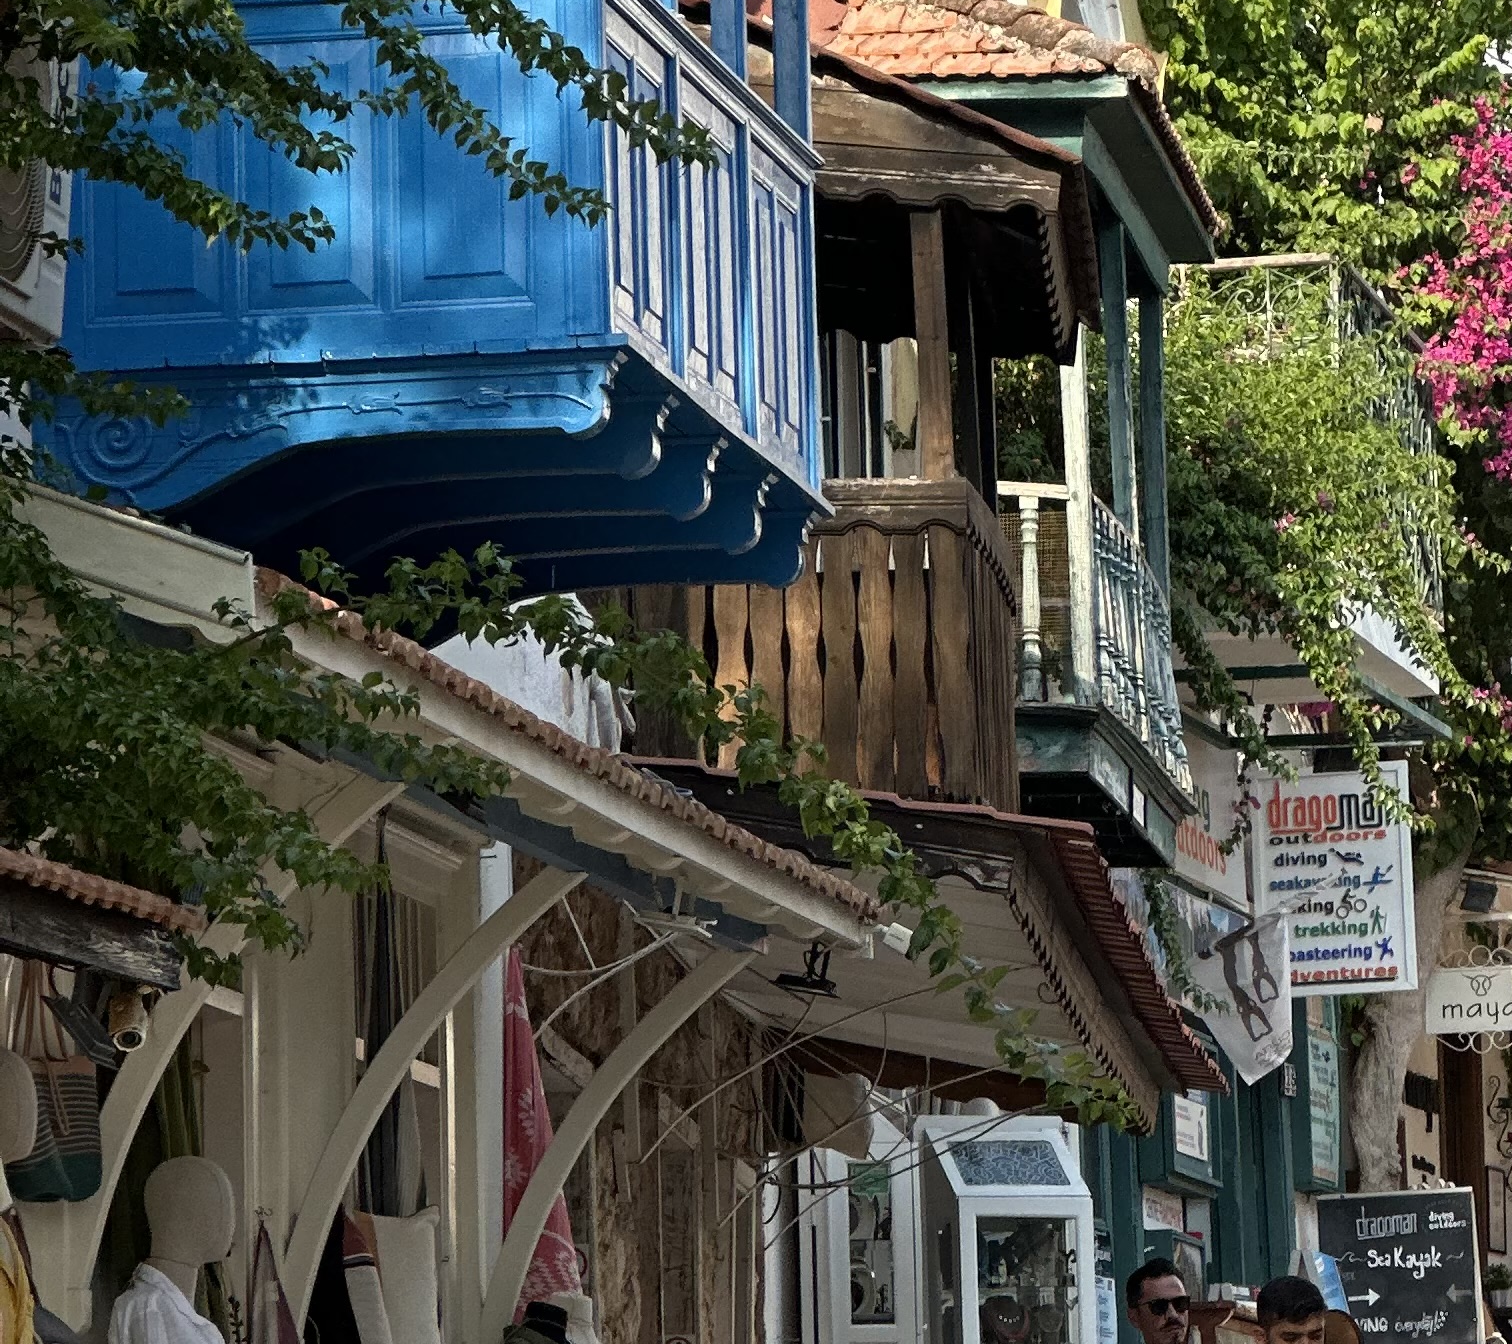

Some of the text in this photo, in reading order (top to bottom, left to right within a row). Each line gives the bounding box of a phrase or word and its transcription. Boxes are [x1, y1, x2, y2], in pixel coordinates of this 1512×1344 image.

[1177, 817, 1227, 876] utdoors
[1269, 828, 1387, 846] outdoors
[1274, 851, 1328, 868] diving
[1294, 921, 1369, 939] trekking
[1290, 943, 1373, 963] oasteering
[1291, 965, 1398, 982] dventures
[1356, 1206, 1417, 1240] dragoman
[1394, 1245, 1442, 1279] Kayak
